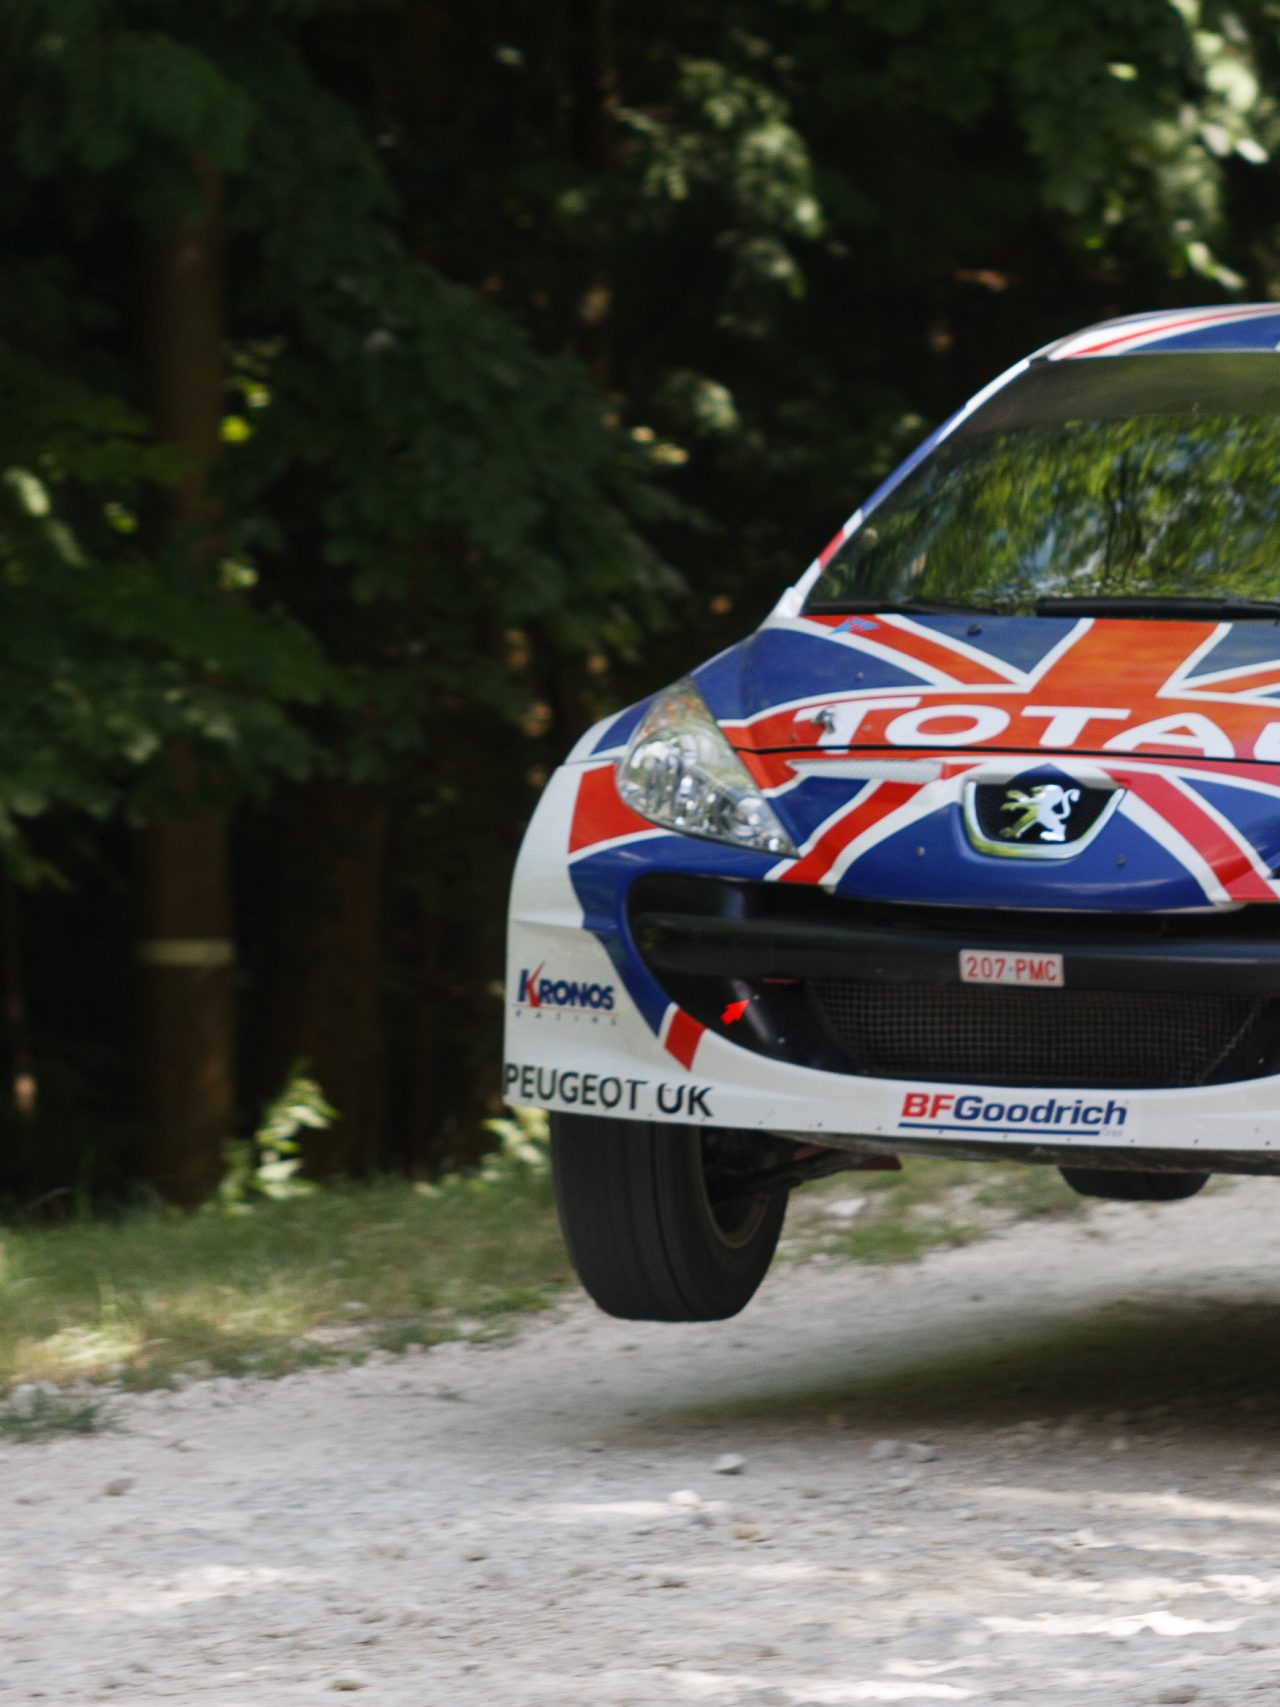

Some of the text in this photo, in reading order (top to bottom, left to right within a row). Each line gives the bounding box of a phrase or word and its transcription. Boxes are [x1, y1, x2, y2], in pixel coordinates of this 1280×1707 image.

[518, 960, 615, 1010] KRONOS
[504, 1063, 714, 1118] PEUGEOT UK
[901, 1092, 1128, 1126] BFGoodrich
